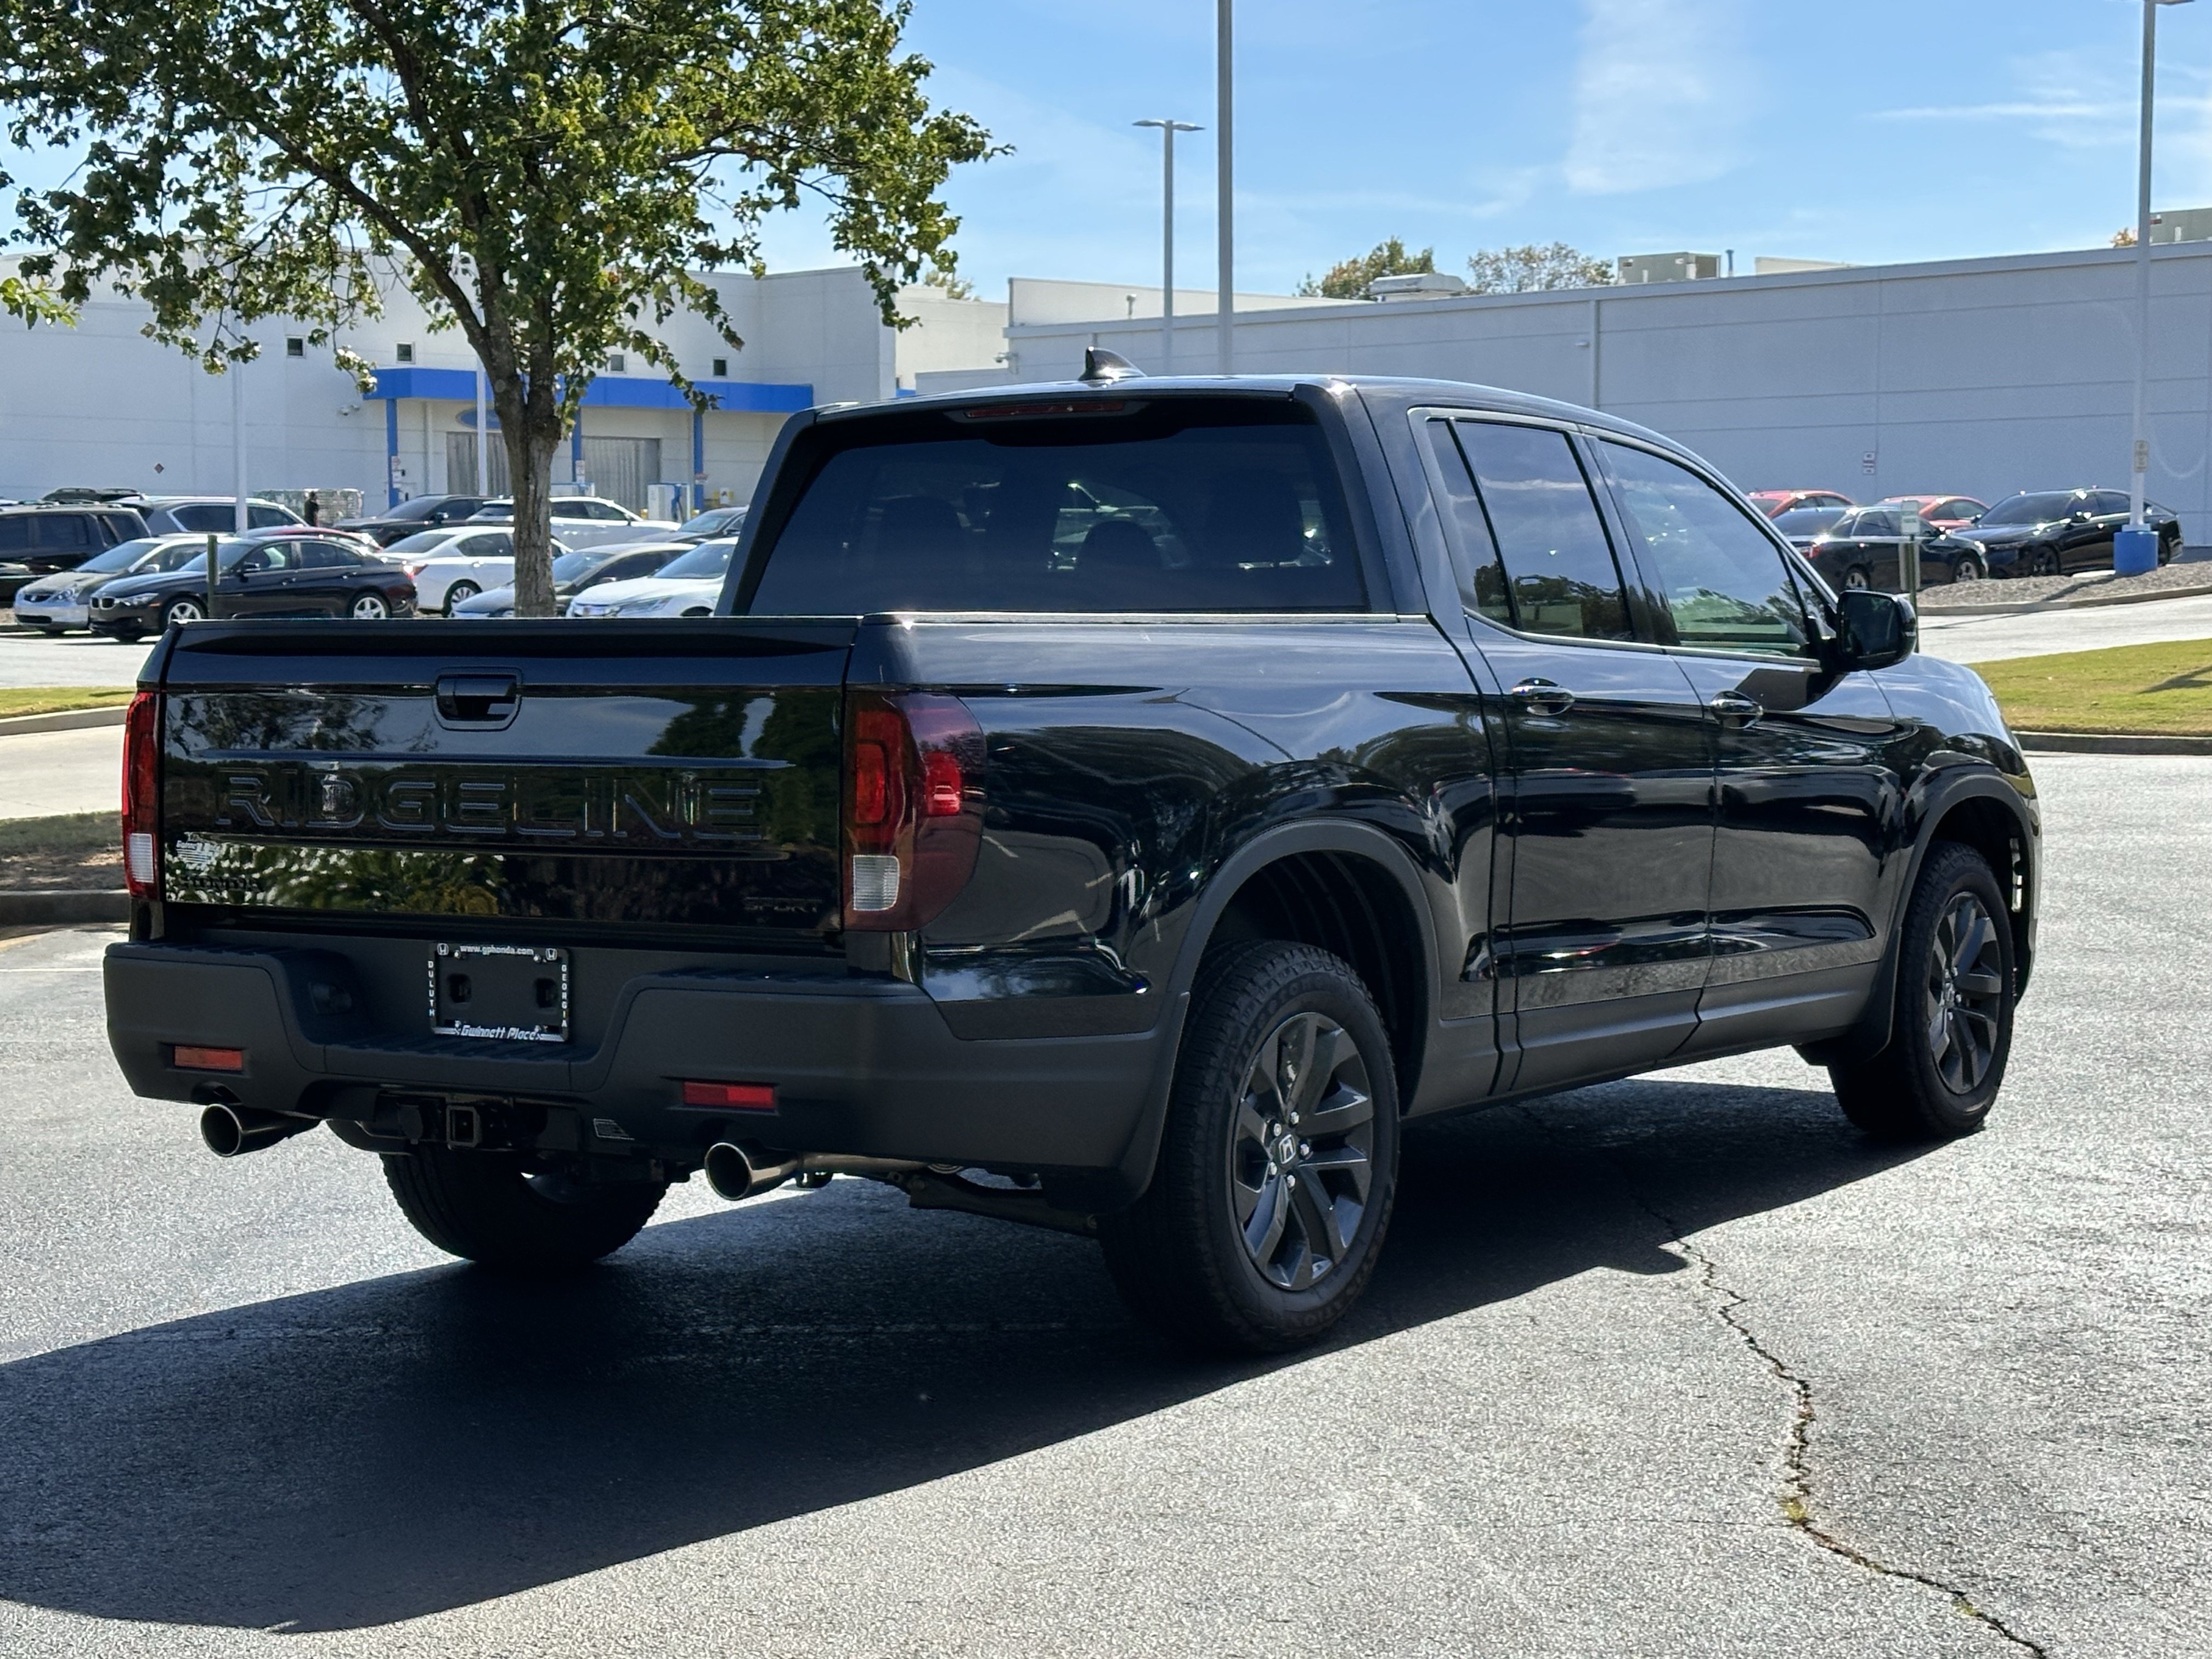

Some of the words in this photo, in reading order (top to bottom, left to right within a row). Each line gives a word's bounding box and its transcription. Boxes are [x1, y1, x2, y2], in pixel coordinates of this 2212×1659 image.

[215, 767, 762, 840] RIDGELINE
[459, 944, 534, 956] www.gphonda.com
[461, 1024, 505, 1039] Gwinnett
[506, 1028, 535, 1040] Place
